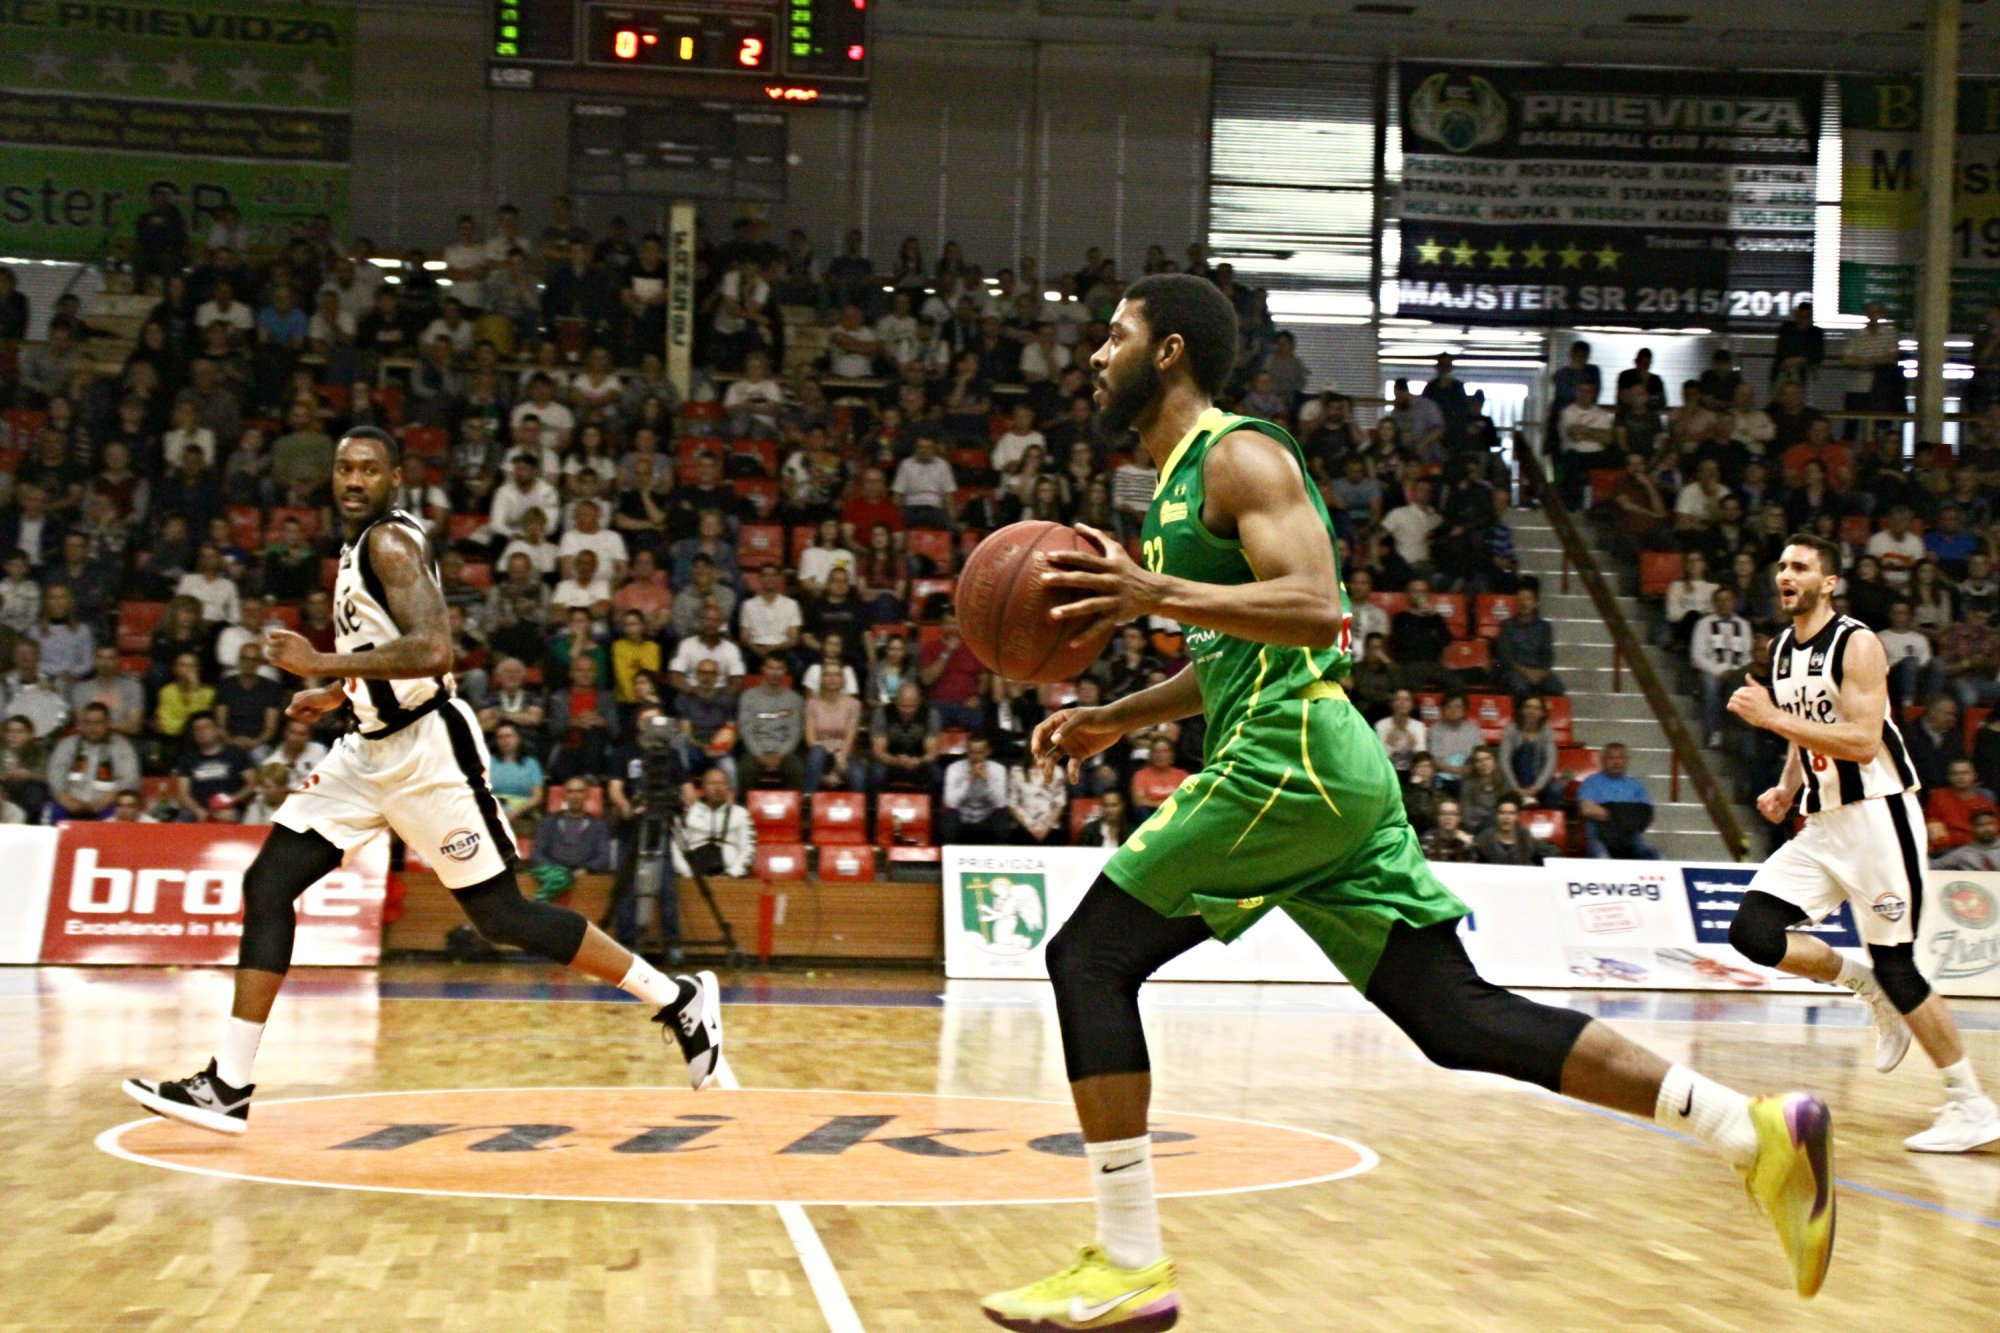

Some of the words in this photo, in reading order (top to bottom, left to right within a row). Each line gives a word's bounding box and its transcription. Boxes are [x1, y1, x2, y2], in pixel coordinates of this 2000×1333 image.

[56, 3, 339, 47] PRIEVIDZA
[740, 38, 762, 66] 2
[1521, 97, 1810, 134] PRIEVIDZA
[1401, 280, 1569, 310] MAJSTER
[1578, 285, 1627, 313] SR
[440, 832, 481, 855] msm
[68, 848, 362, 917] broe
[1568, 880, 1661, 900] pewag
[187, 921, 210, 936] in
